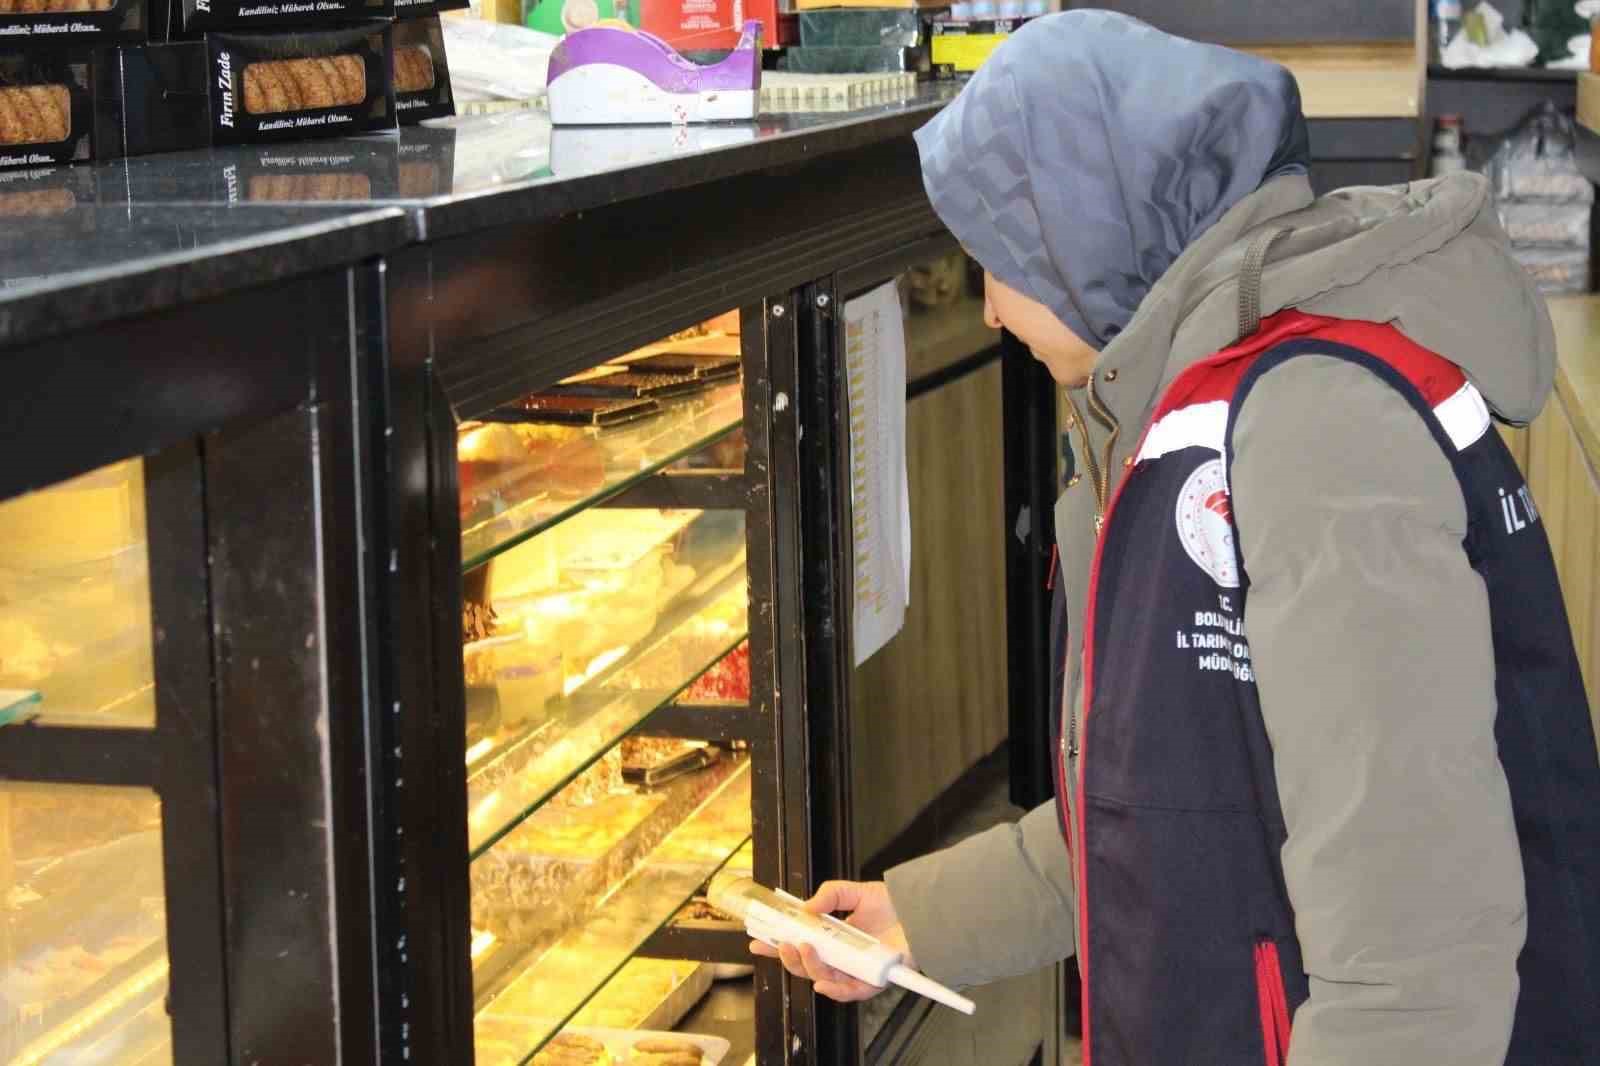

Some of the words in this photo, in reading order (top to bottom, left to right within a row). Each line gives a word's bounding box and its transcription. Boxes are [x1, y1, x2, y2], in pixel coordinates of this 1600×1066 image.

[279, 3, 314, 14] Mübarek
[217, 51, 232, 89] Zade
[1176, 630, 1190, 648] İL
